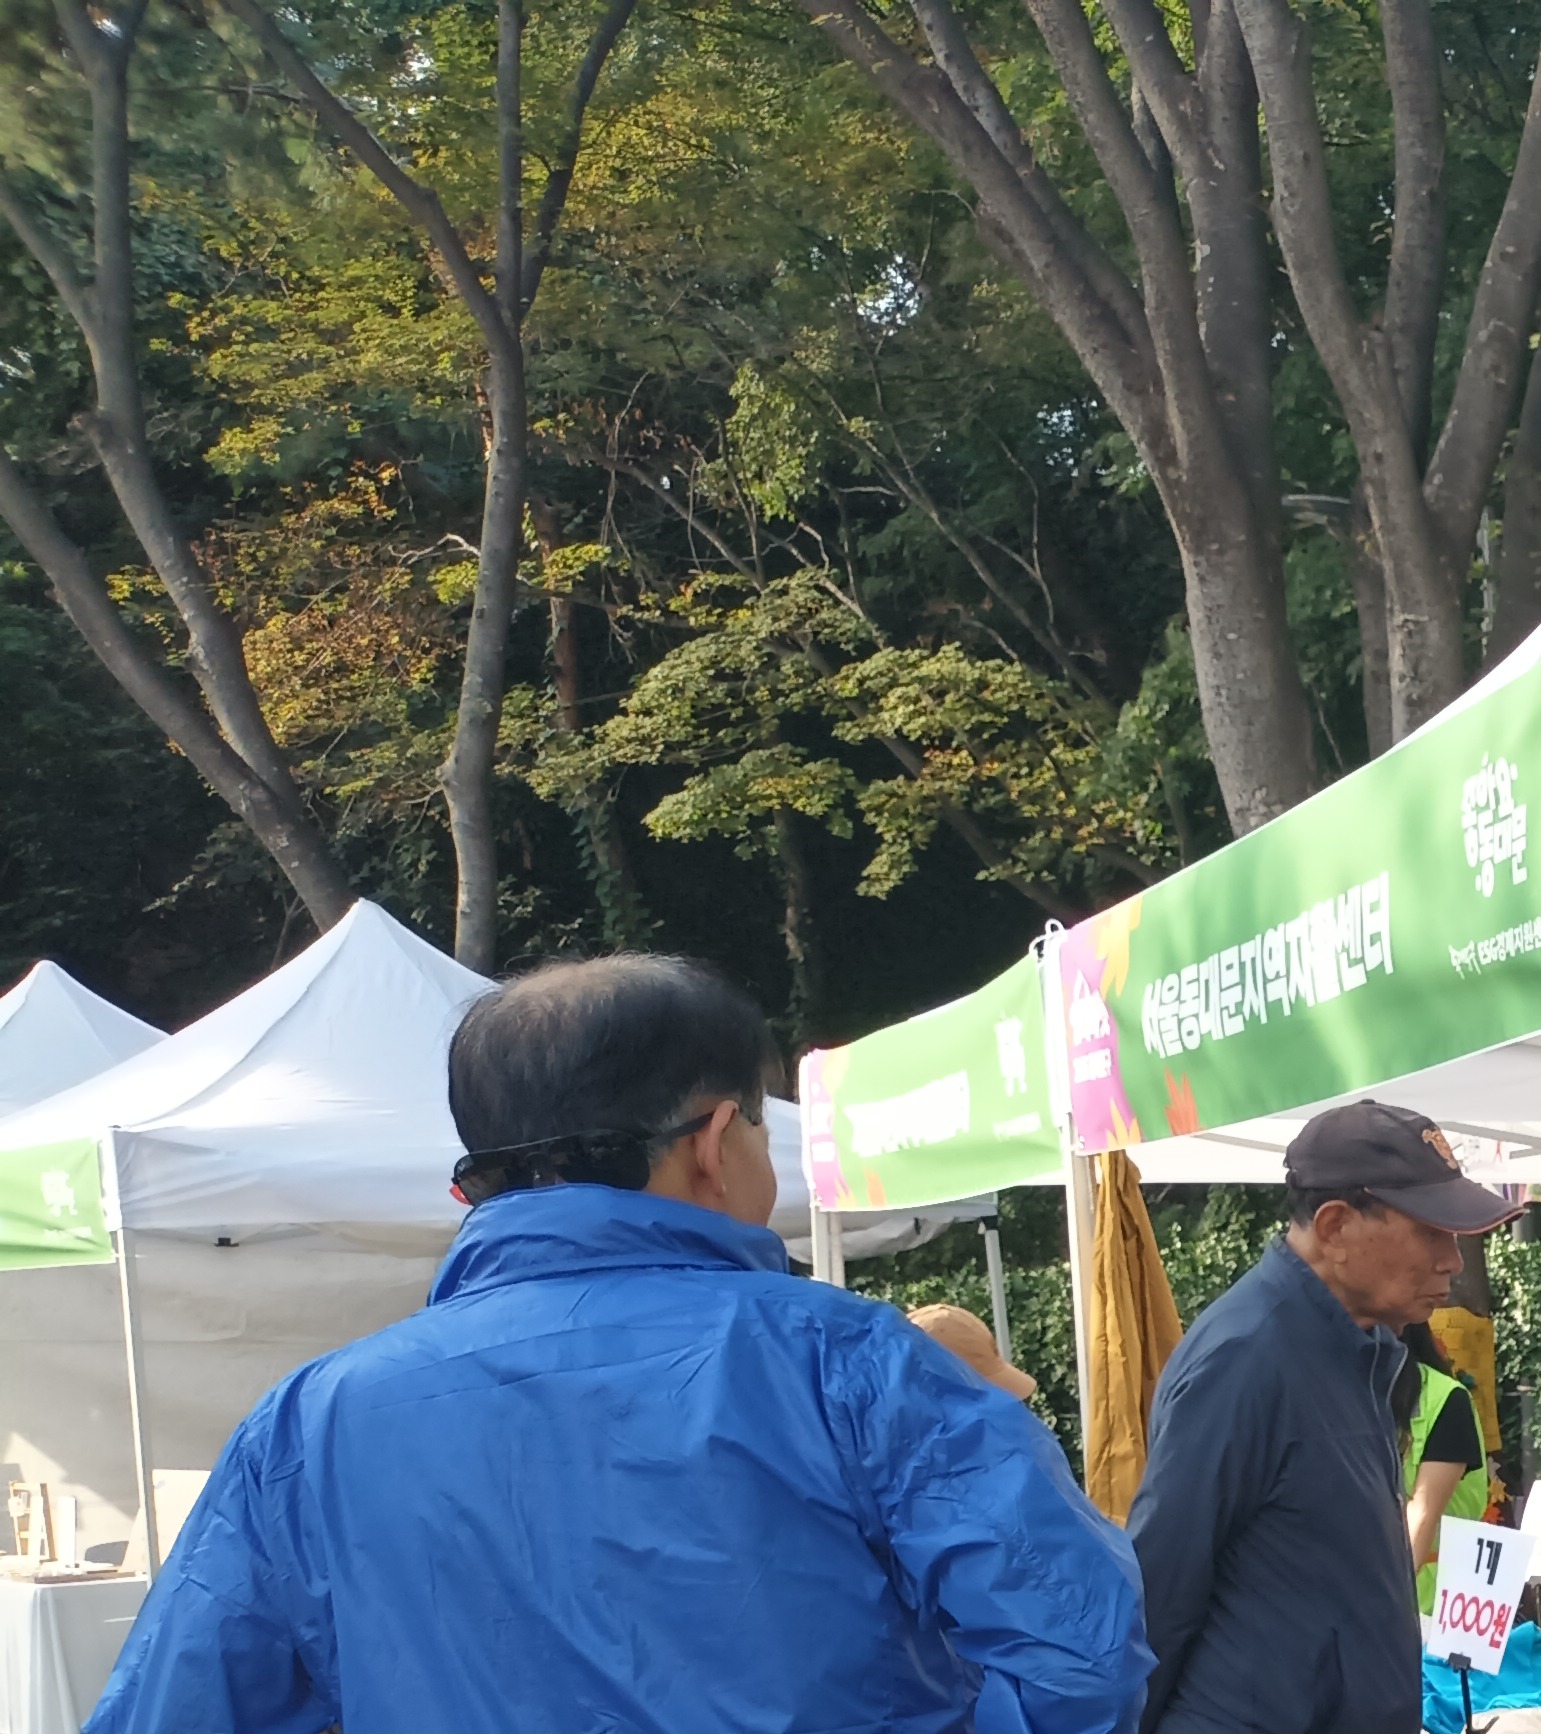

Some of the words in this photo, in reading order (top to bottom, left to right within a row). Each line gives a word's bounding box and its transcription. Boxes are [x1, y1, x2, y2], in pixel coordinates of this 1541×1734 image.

[1141, 870, 1394, 1059] 서울동대문지역자활센터
[1474, 1537, 1503, 1586] 1개
[1438, 1588, 1512, 1649] 1,000원
